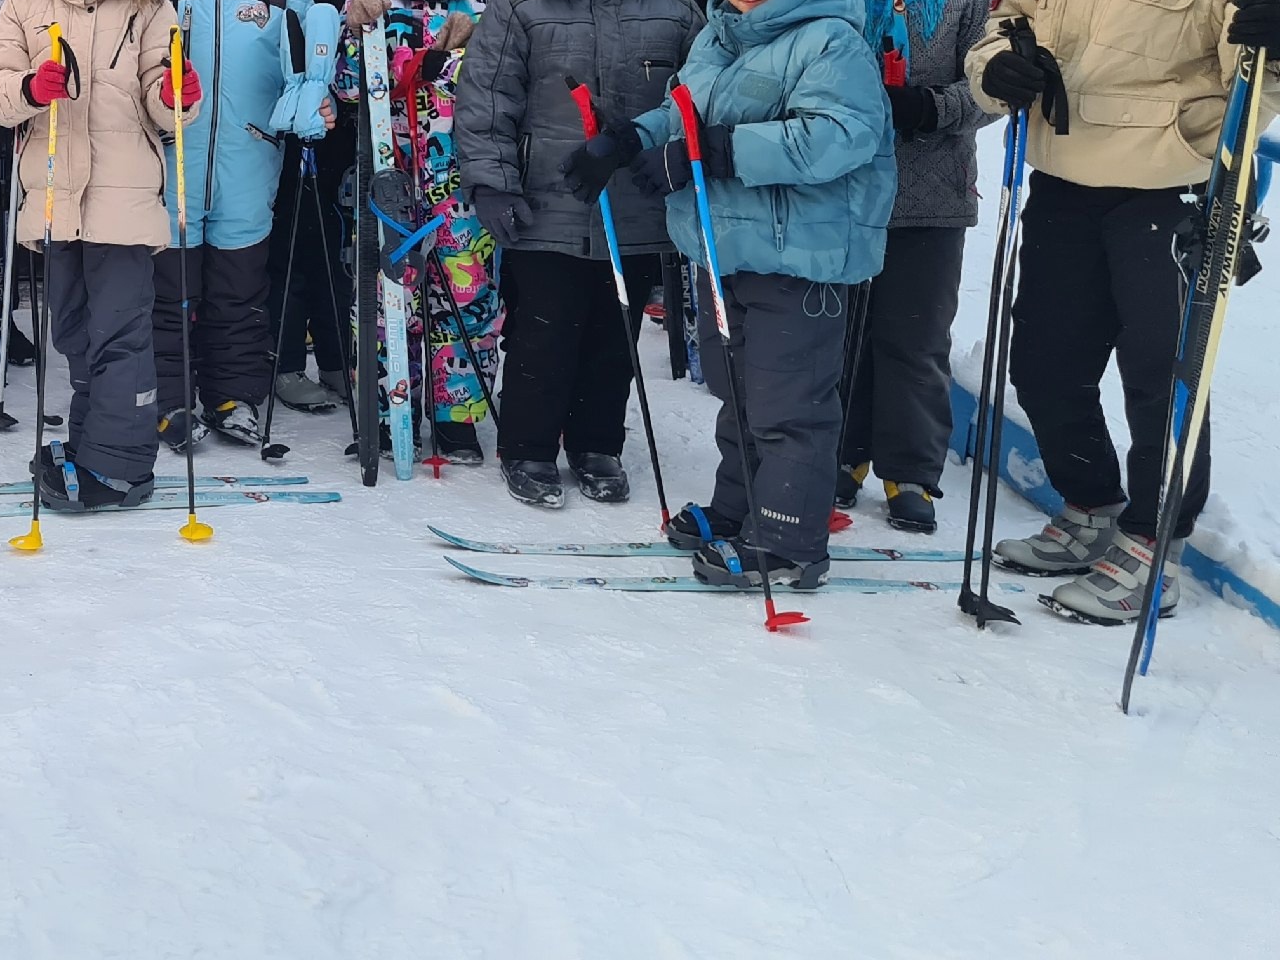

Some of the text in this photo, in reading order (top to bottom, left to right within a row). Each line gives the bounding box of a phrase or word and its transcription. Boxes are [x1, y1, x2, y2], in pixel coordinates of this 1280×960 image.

[681, 264, 691, 309] JUNIOR
[1196, 196, 1223, 294] NORDWAY
[1218, 202, 1242, 298] NORDWAY
